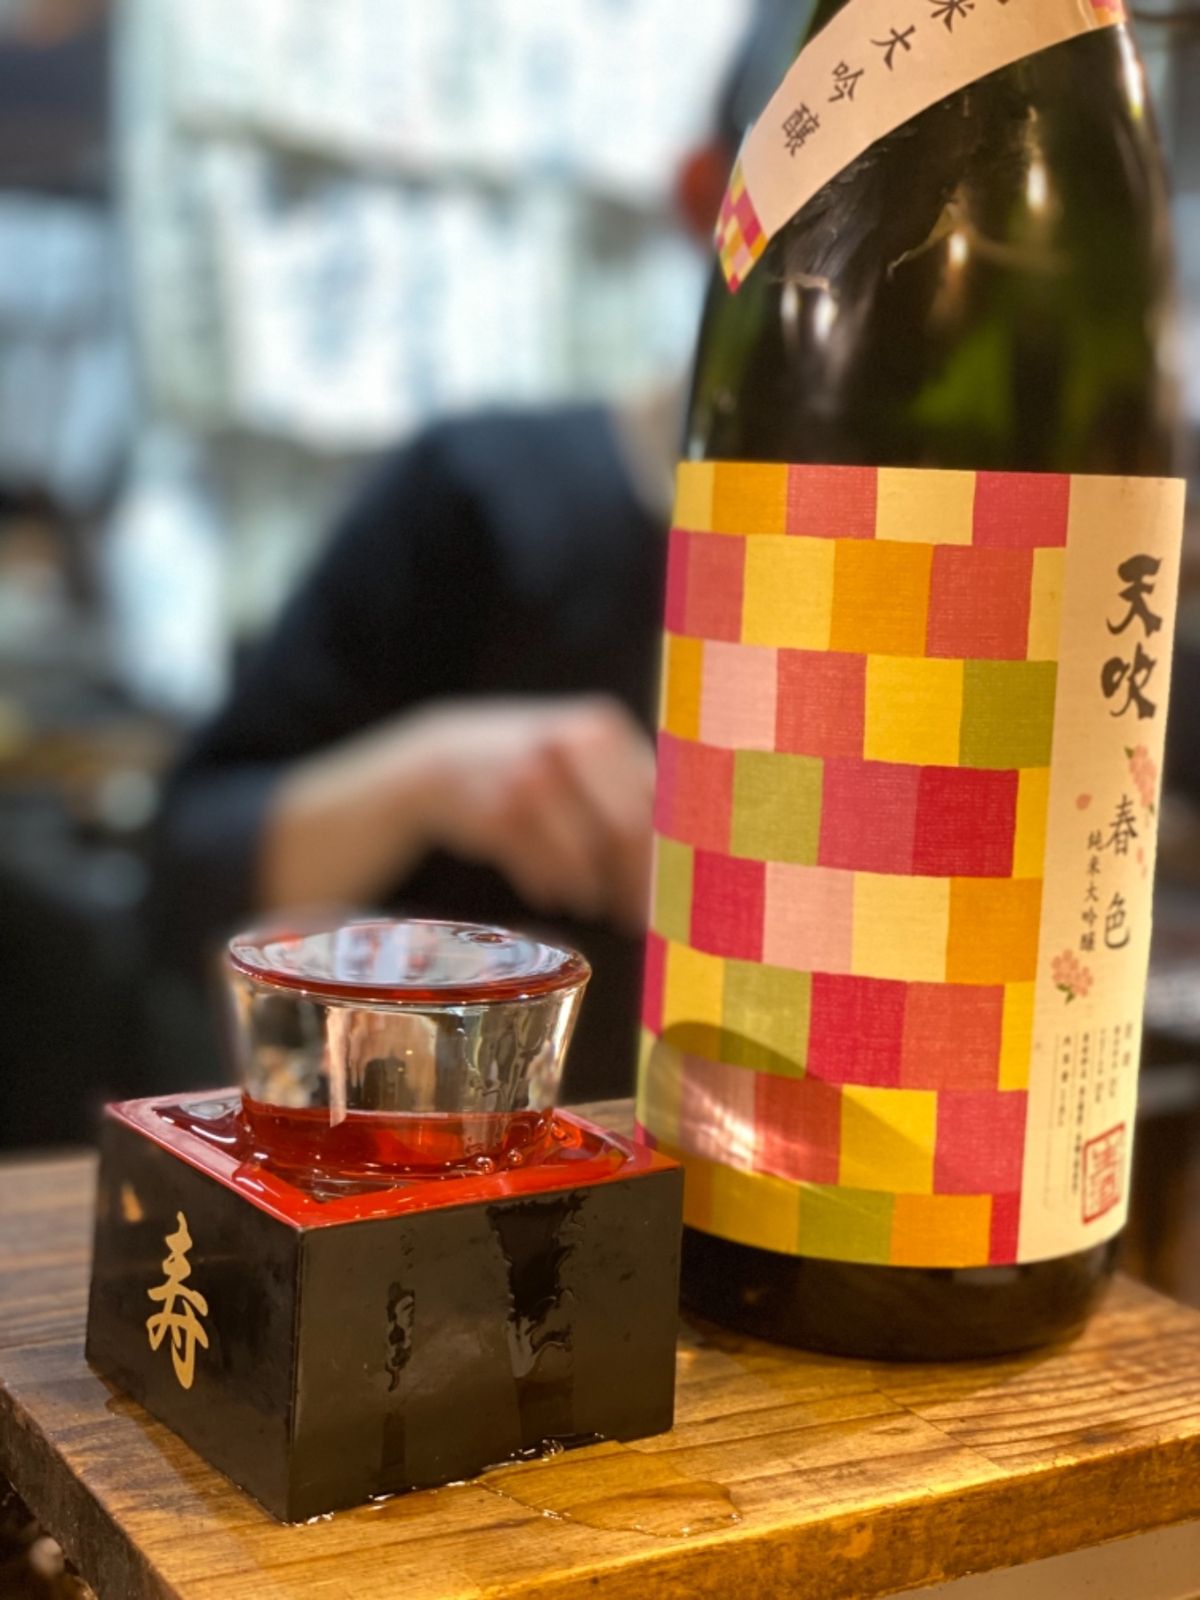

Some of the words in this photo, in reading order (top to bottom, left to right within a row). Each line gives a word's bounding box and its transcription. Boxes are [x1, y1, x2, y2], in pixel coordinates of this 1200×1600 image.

[781, 0, 1010, 157] 米大吟醸
[1101, 553, 1163, 720] 天吹
[1104, 793, 1138, 949] 春色
